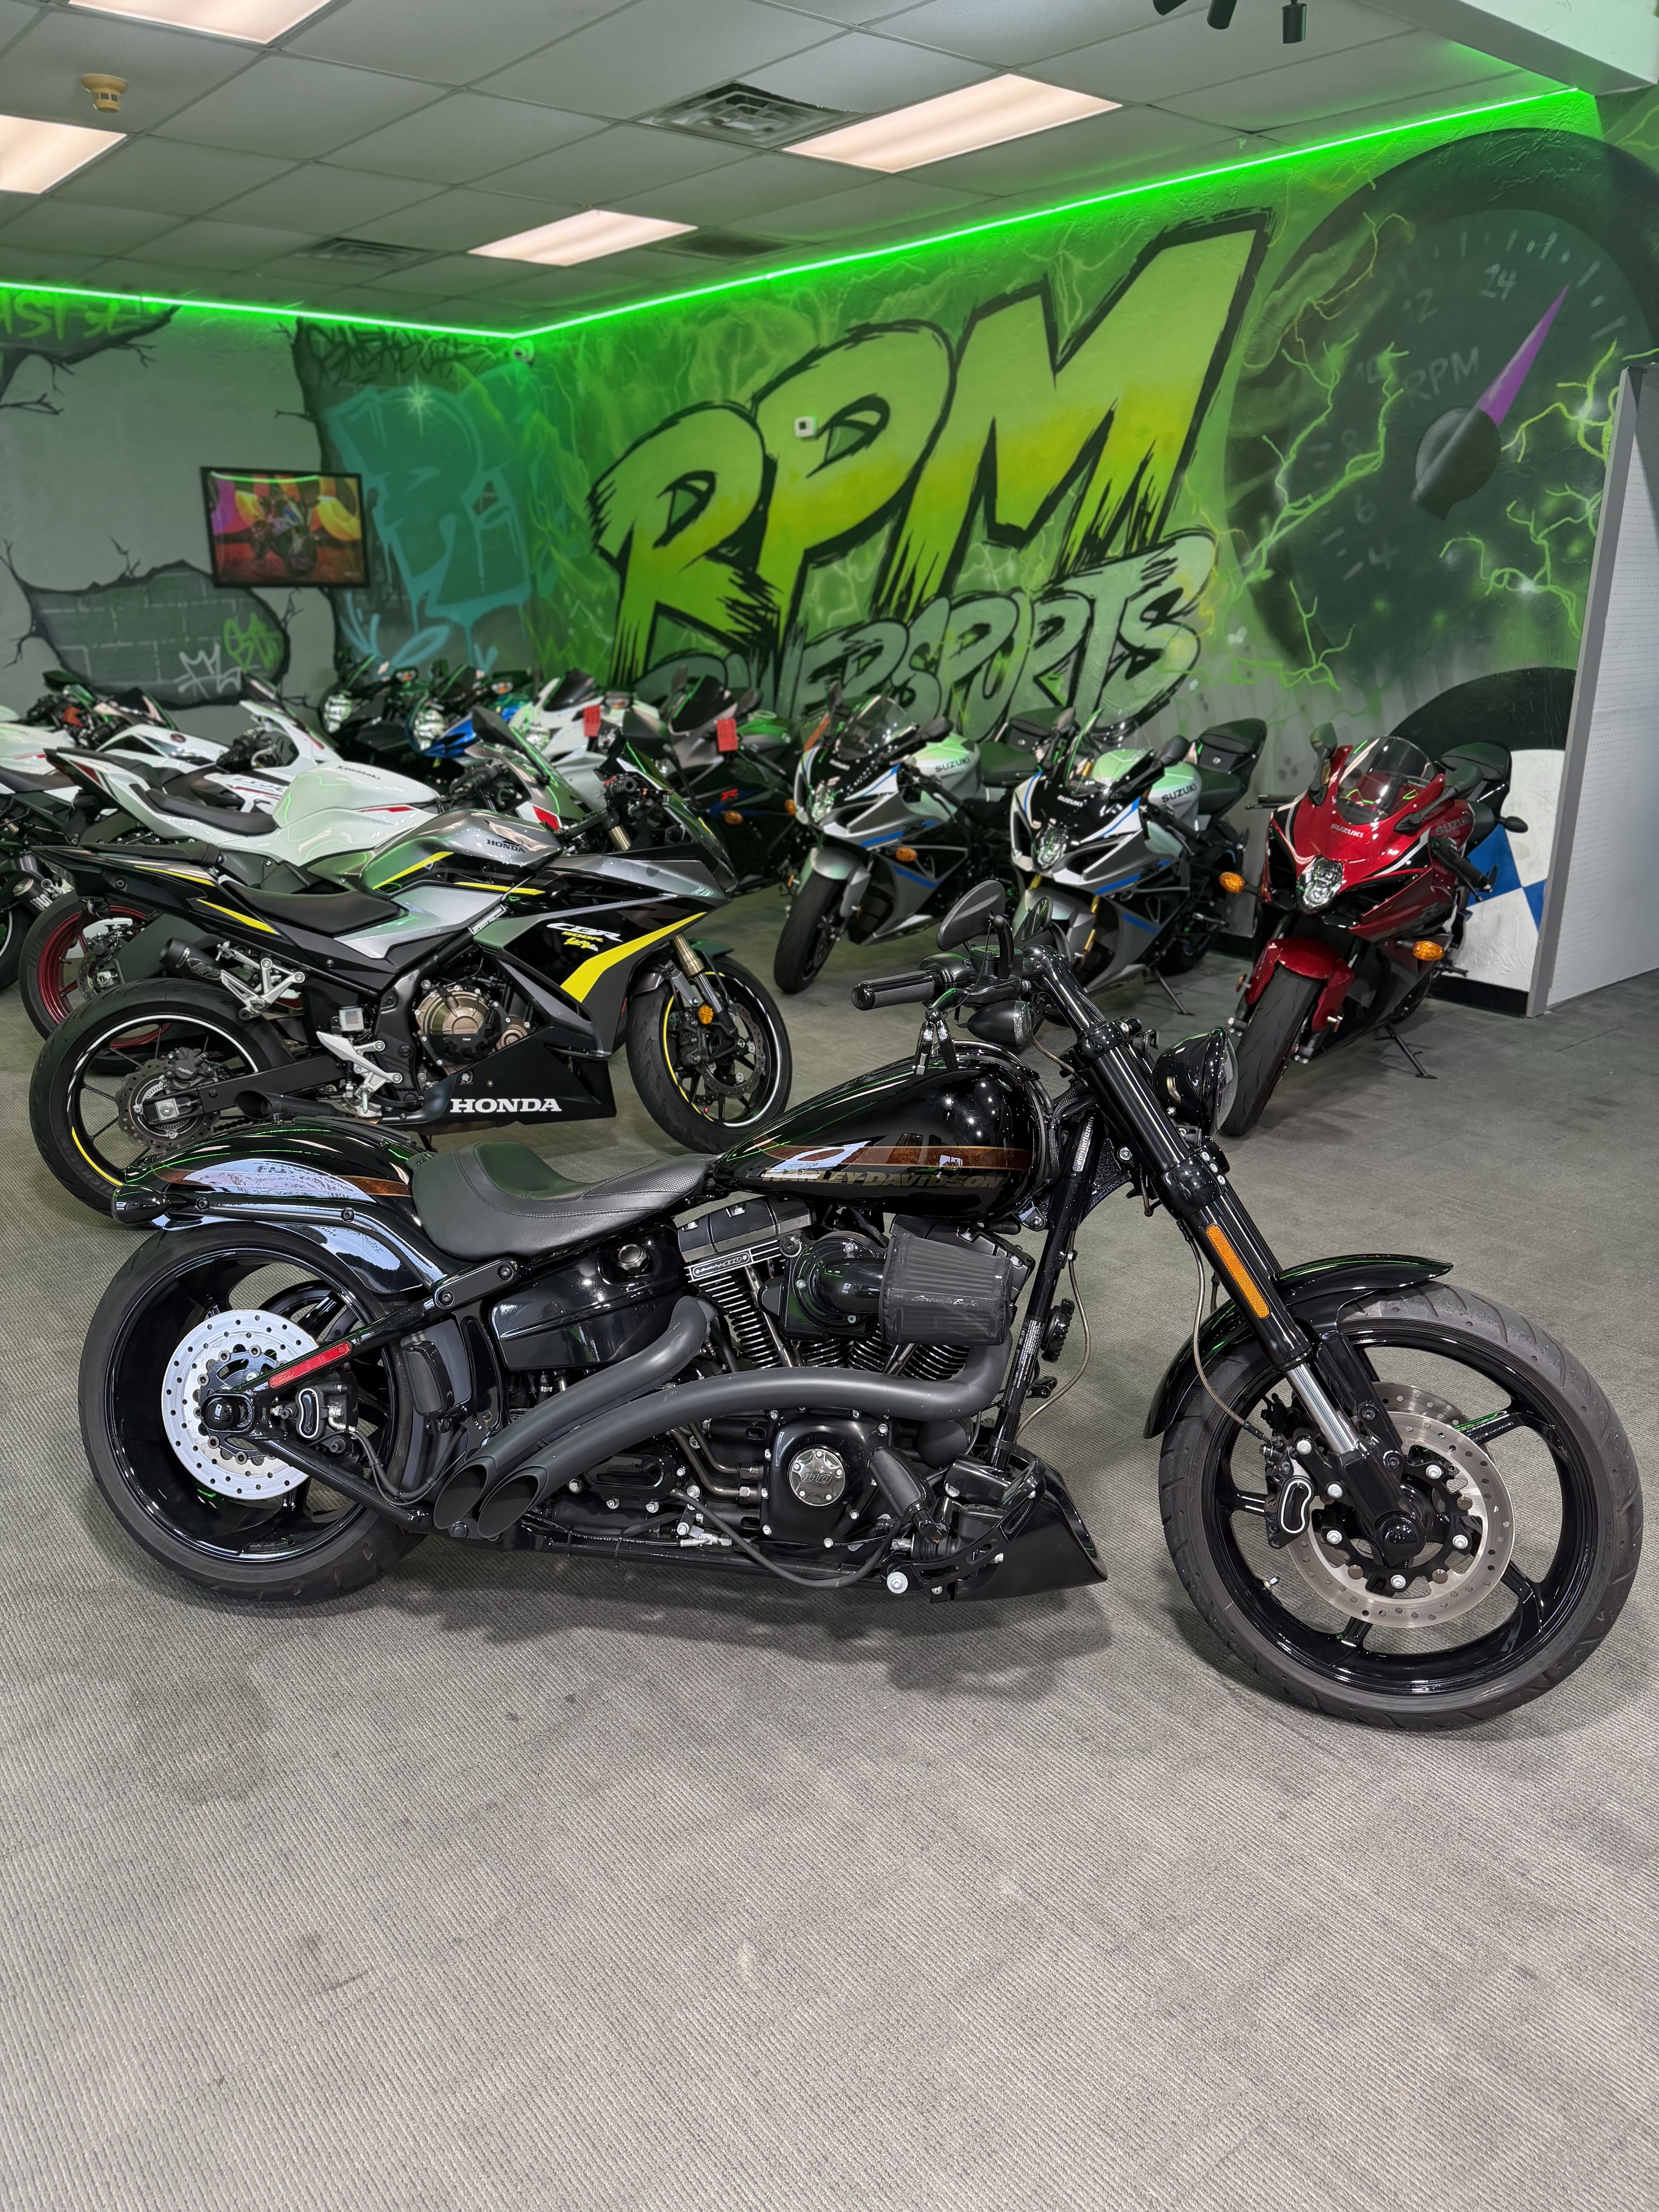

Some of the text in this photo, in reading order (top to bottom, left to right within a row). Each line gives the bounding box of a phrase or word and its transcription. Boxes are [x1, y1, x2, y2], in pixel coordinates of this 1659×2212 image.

[1401, 347, 1479, 407] RPM
[588, 209, 1272, 687] RPM
[1368, 544, 1400, 570] 4
[337, 764, 381, 780] Kawasaki
[829, 759, 851, 771] SUZUKI
[934, 757, 971, 773] SUZUKI
[1056, 794, 1085, 807] SUZUKI
[1161, 782, 1197, 803] SUZUKI
[1330, 823, 1364, 838] SUZUKI
[1435, 814, 1472, 836] SUZUKI
[486, 839, 526, 853] HONDA
[546, 922, 623, 942] CBR
[450, 1098, 562, 1113] HONDA
[803, 1472, 832, 1484] 110
